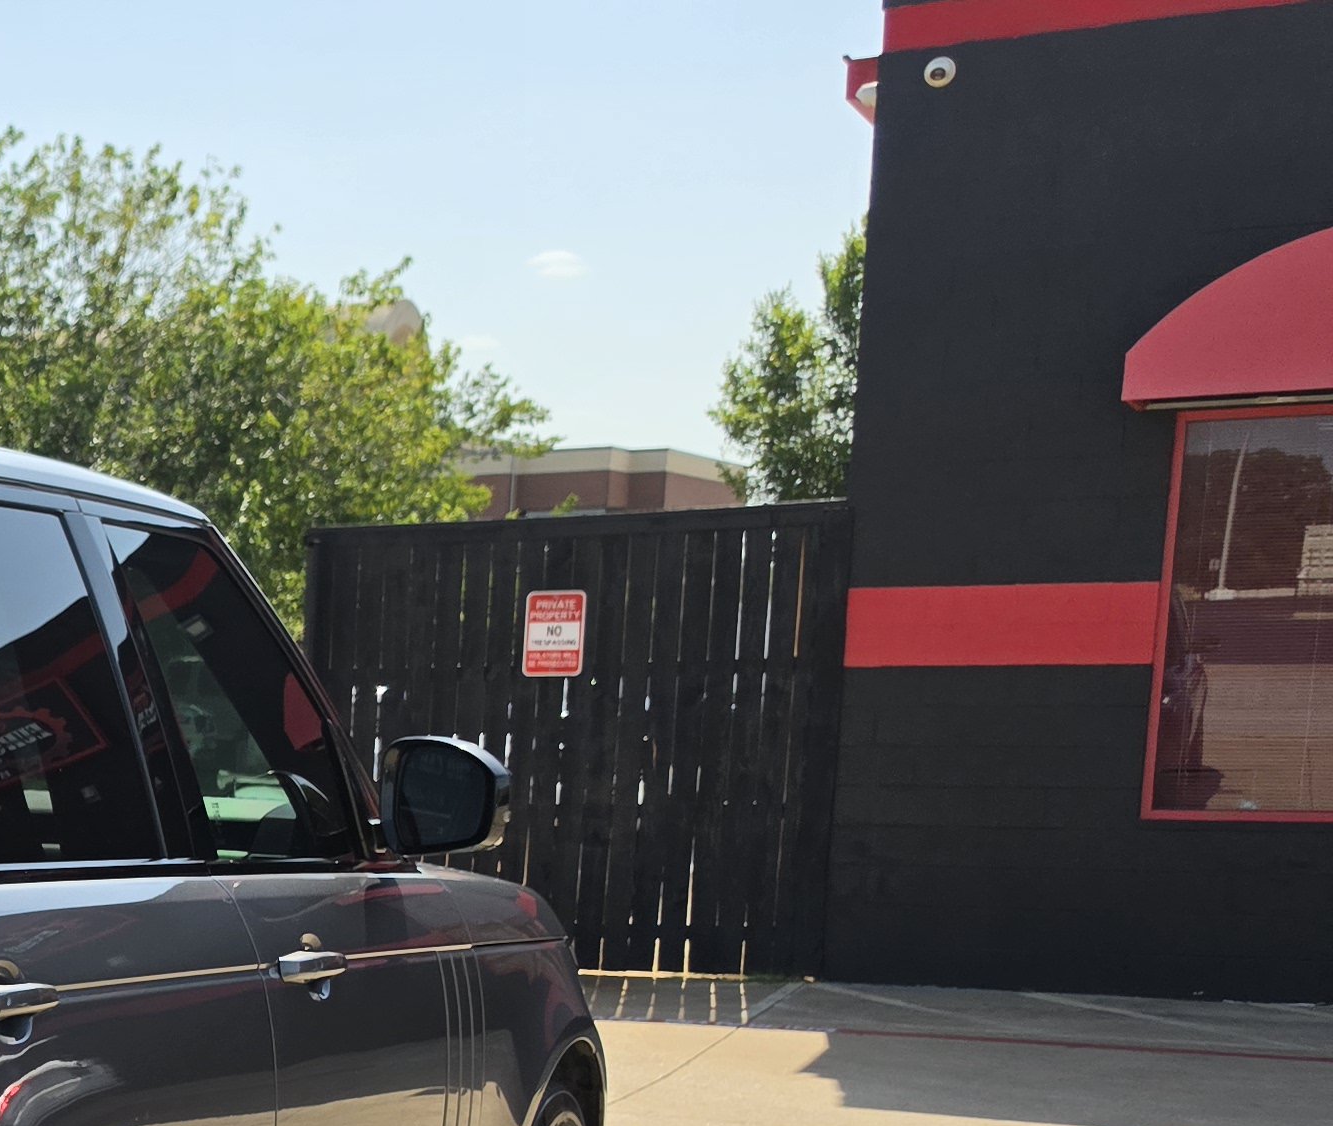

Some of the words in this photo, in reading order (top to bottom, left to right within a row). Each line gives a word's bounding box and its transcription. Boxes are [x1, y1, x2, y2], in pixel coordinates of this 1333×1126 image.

[536, 599, 577, 610] PRIVATE
[529, 610, 581, 620] PROPERTY
[546, 625, 562, 637] NO
